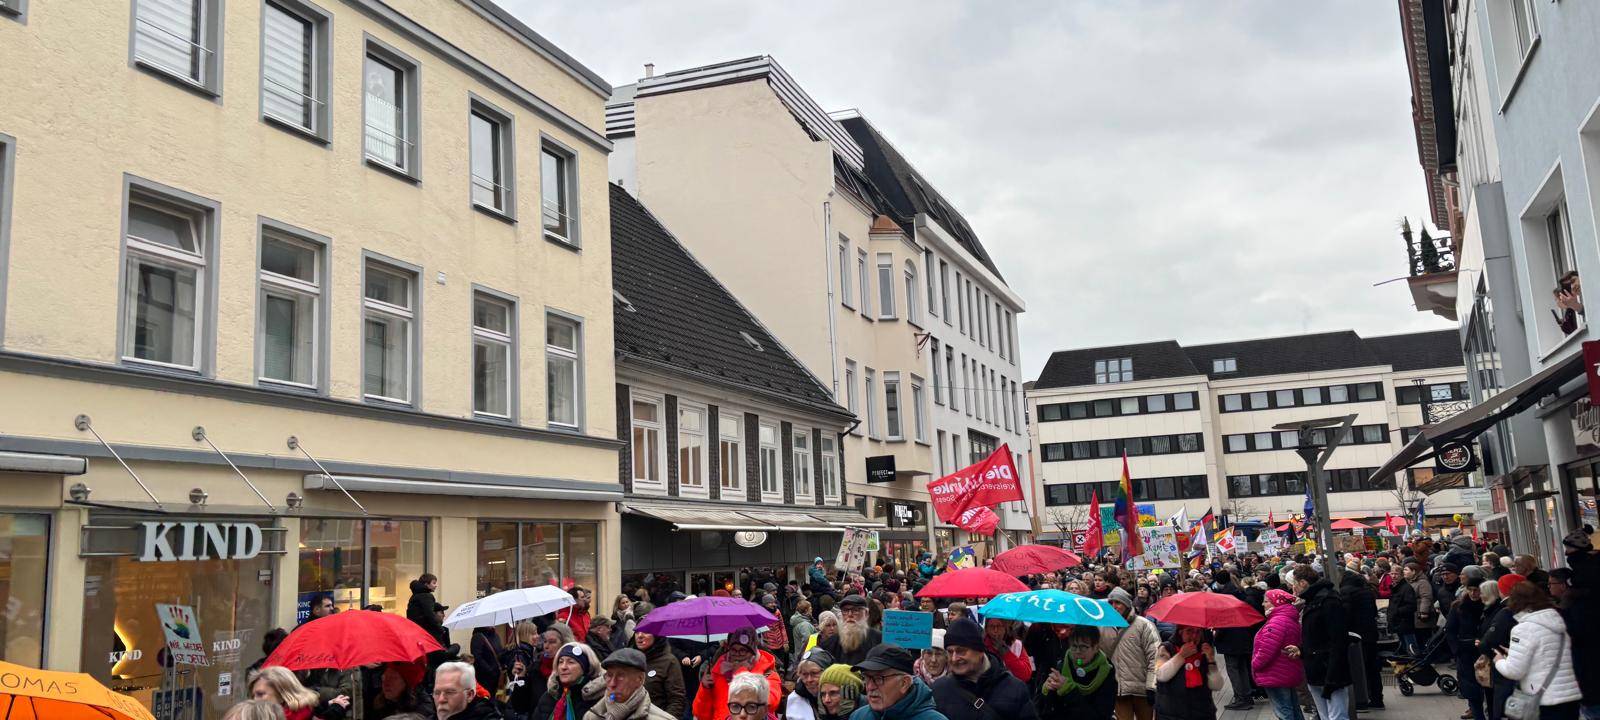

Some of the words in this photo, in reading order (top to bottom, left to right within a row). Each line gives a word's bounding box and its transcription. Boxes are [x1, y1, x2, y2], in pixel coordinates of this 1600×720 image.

[139, 521, 263, 562] KIND
[213, 639, 241, 651] KIND
[109, 650, 143, 664] KIND
[1, 672, 79, 695] OMAS
